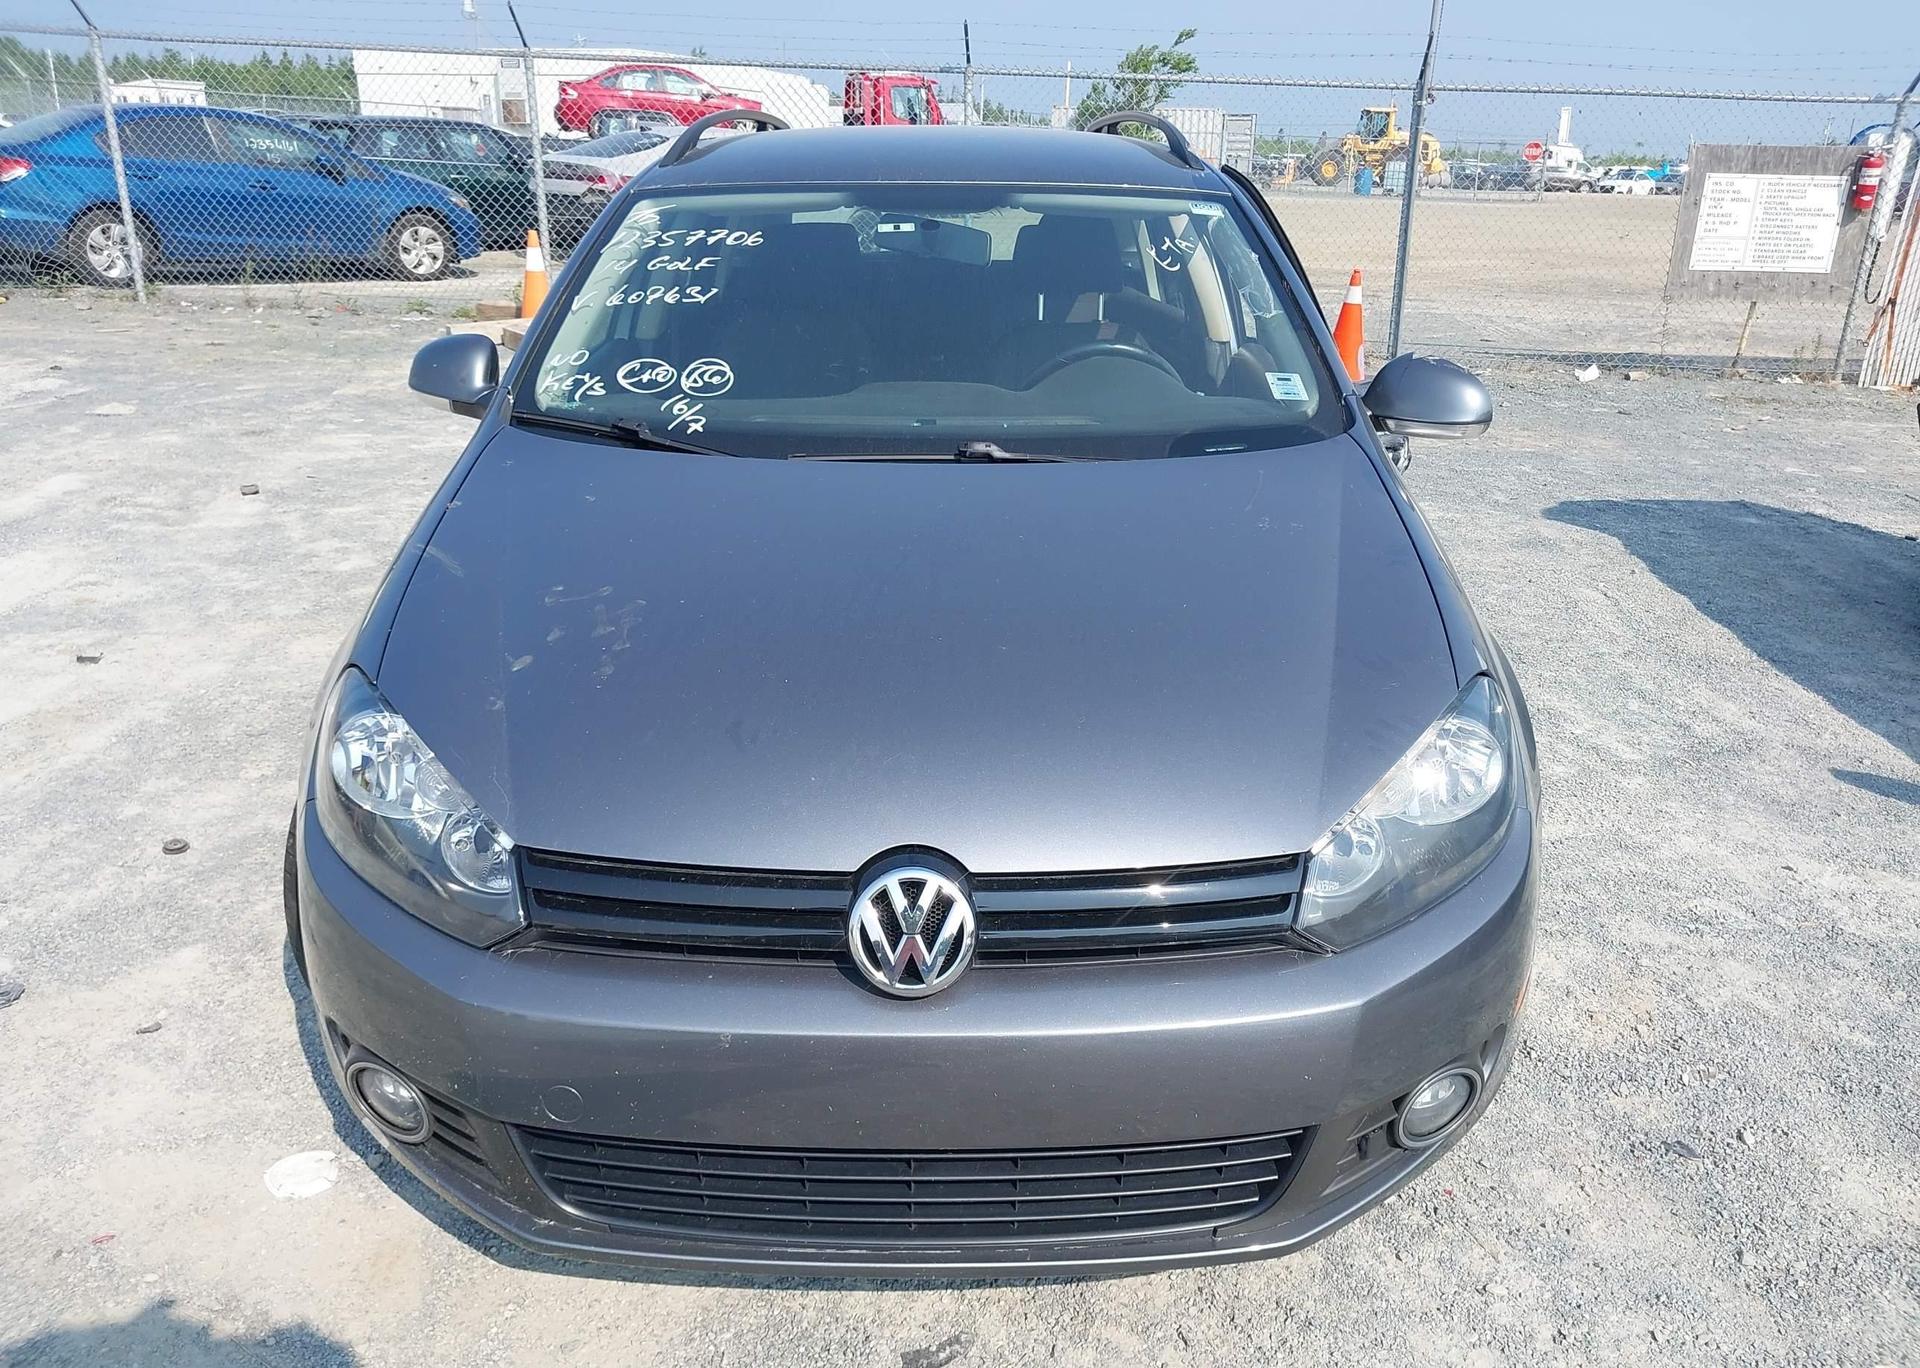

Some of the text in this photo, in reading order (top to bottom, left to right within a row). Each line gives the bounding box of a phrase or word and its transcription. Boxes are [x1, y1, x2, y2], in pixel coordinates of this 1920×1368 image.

[646, 255, 722, 271] GOLF
[550, 349, 590, 367] NO
[538, 370, 607, 402] KEYS
